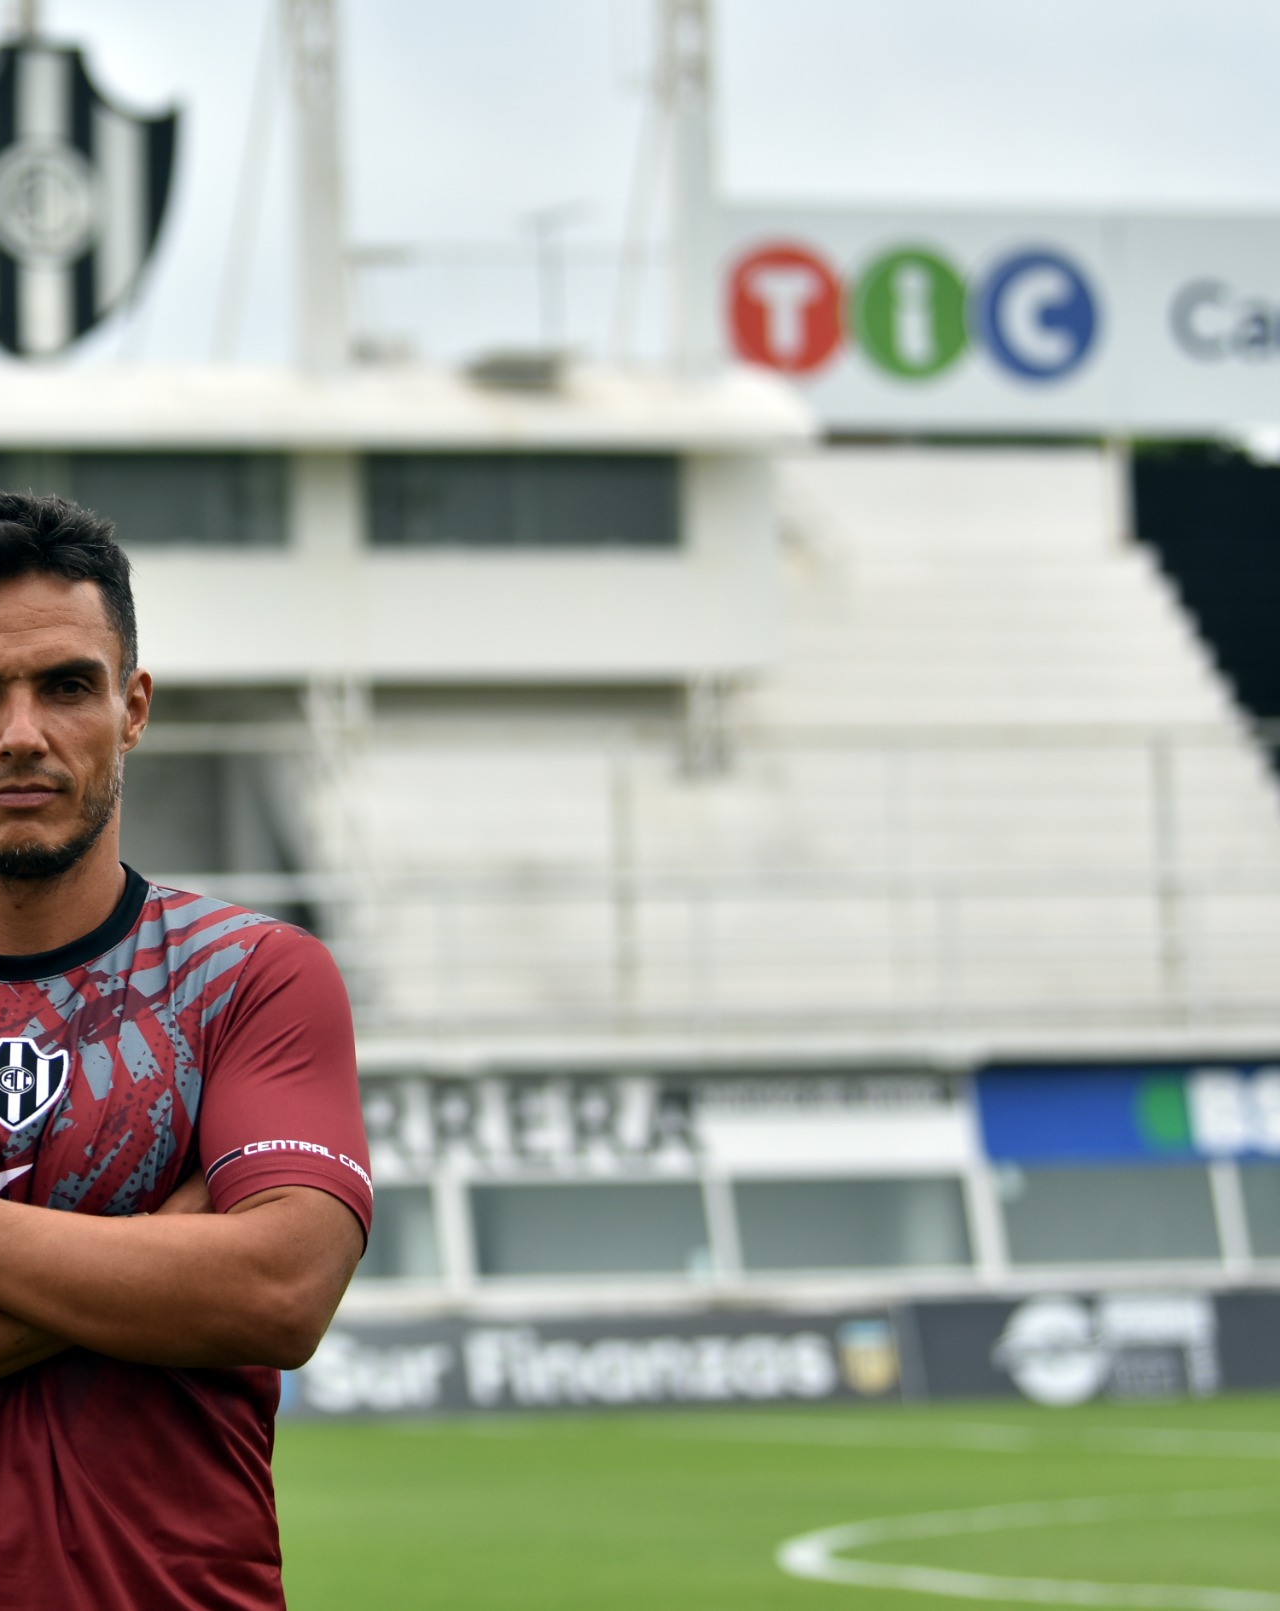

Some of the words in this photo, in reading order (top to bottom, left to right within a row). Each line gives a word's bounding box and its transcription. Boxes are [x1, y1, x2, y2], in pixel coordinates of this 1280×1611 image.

[1168, 276, 1280, 364] Ca
[243, 1139, 336, 1160] CENTRAL
[305, 1330, 455, 1412] Sur
[465, 1318, 834, 1406] Finanzas
